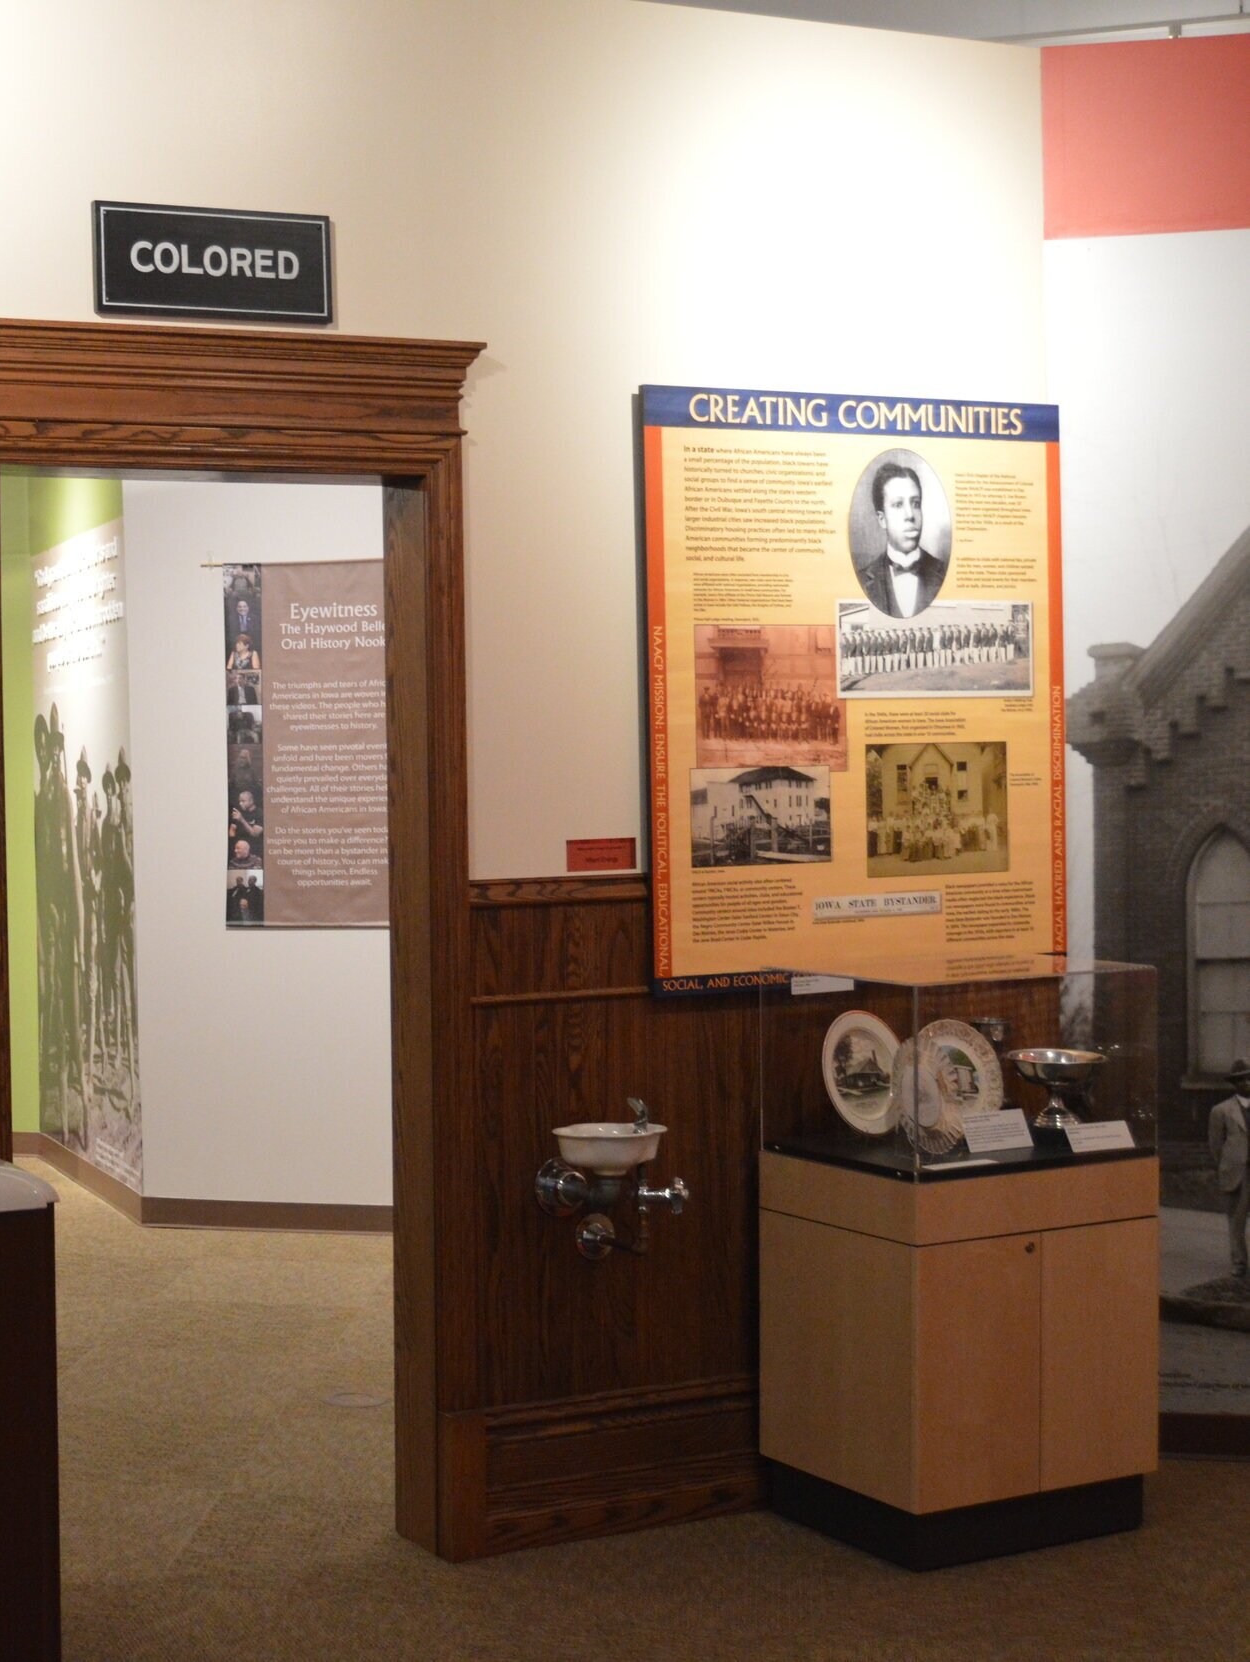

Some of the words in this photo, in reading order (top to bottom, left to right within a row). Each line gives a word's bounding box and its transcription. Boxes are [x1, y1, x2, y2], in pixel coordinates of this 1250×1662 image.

[130, 241, 299, 280] COLORED
[689, 394, 827, 426] CREATING
[838, 400, 1023, 436] COMMUNITIES
[290, 603, 377, 622] Eyewitness
[280, 623, 300, 634] The
[305, 622, 356, 635] Haywood
[281, 638, 306, 649] Oral
[311, 637, 350, 650] History
[355, 636, 385, 648] Nook
[653, 626, 664, 669] NAACP
[288, 681, 321, 690] triumphs
[334, 701, 360, 710] people
[653, 675, 664, 729] MISSION:
[290, 723, 339, 732] eyewitnesses
[351, 722, 378, 731] history.
[1052, 686, 1062, 780] DISCRIMINATION
[339, 743, 364, 752] pivotal
[654, 734, 666, 779] ENSURE
[656, 784, 666, 807] THE
[1053, 785, 1062, 826] RACIAL
[328, 827, 352, 835] you've
[267, 838, 292, 846] inspire
[656, 813, 668, 879] POLITICAL,
[1054, 830, 1062, 856] AND
[313, 858, 340, 866] history.
[292, 868, 315, 877] things
[318, 868, 347, 877] happen.
[1054, 860, 1063, 904] HATRED
[297, 879, 348, 888] opportunities
[815, 900, 841, 910] IOWA
[848, 899, 876, 908] STATE
[884, 896, 936, 906] BYSTANDER
[656, 884, 669, 976] EDUCATIONAL,
[1054, 909, 1063, 950] RACIAL
[663, 979, 703, 991] SOCIAL,
[707, 978, 729, 988] AND
[734, 974, 789, 987] ECONOMIC
